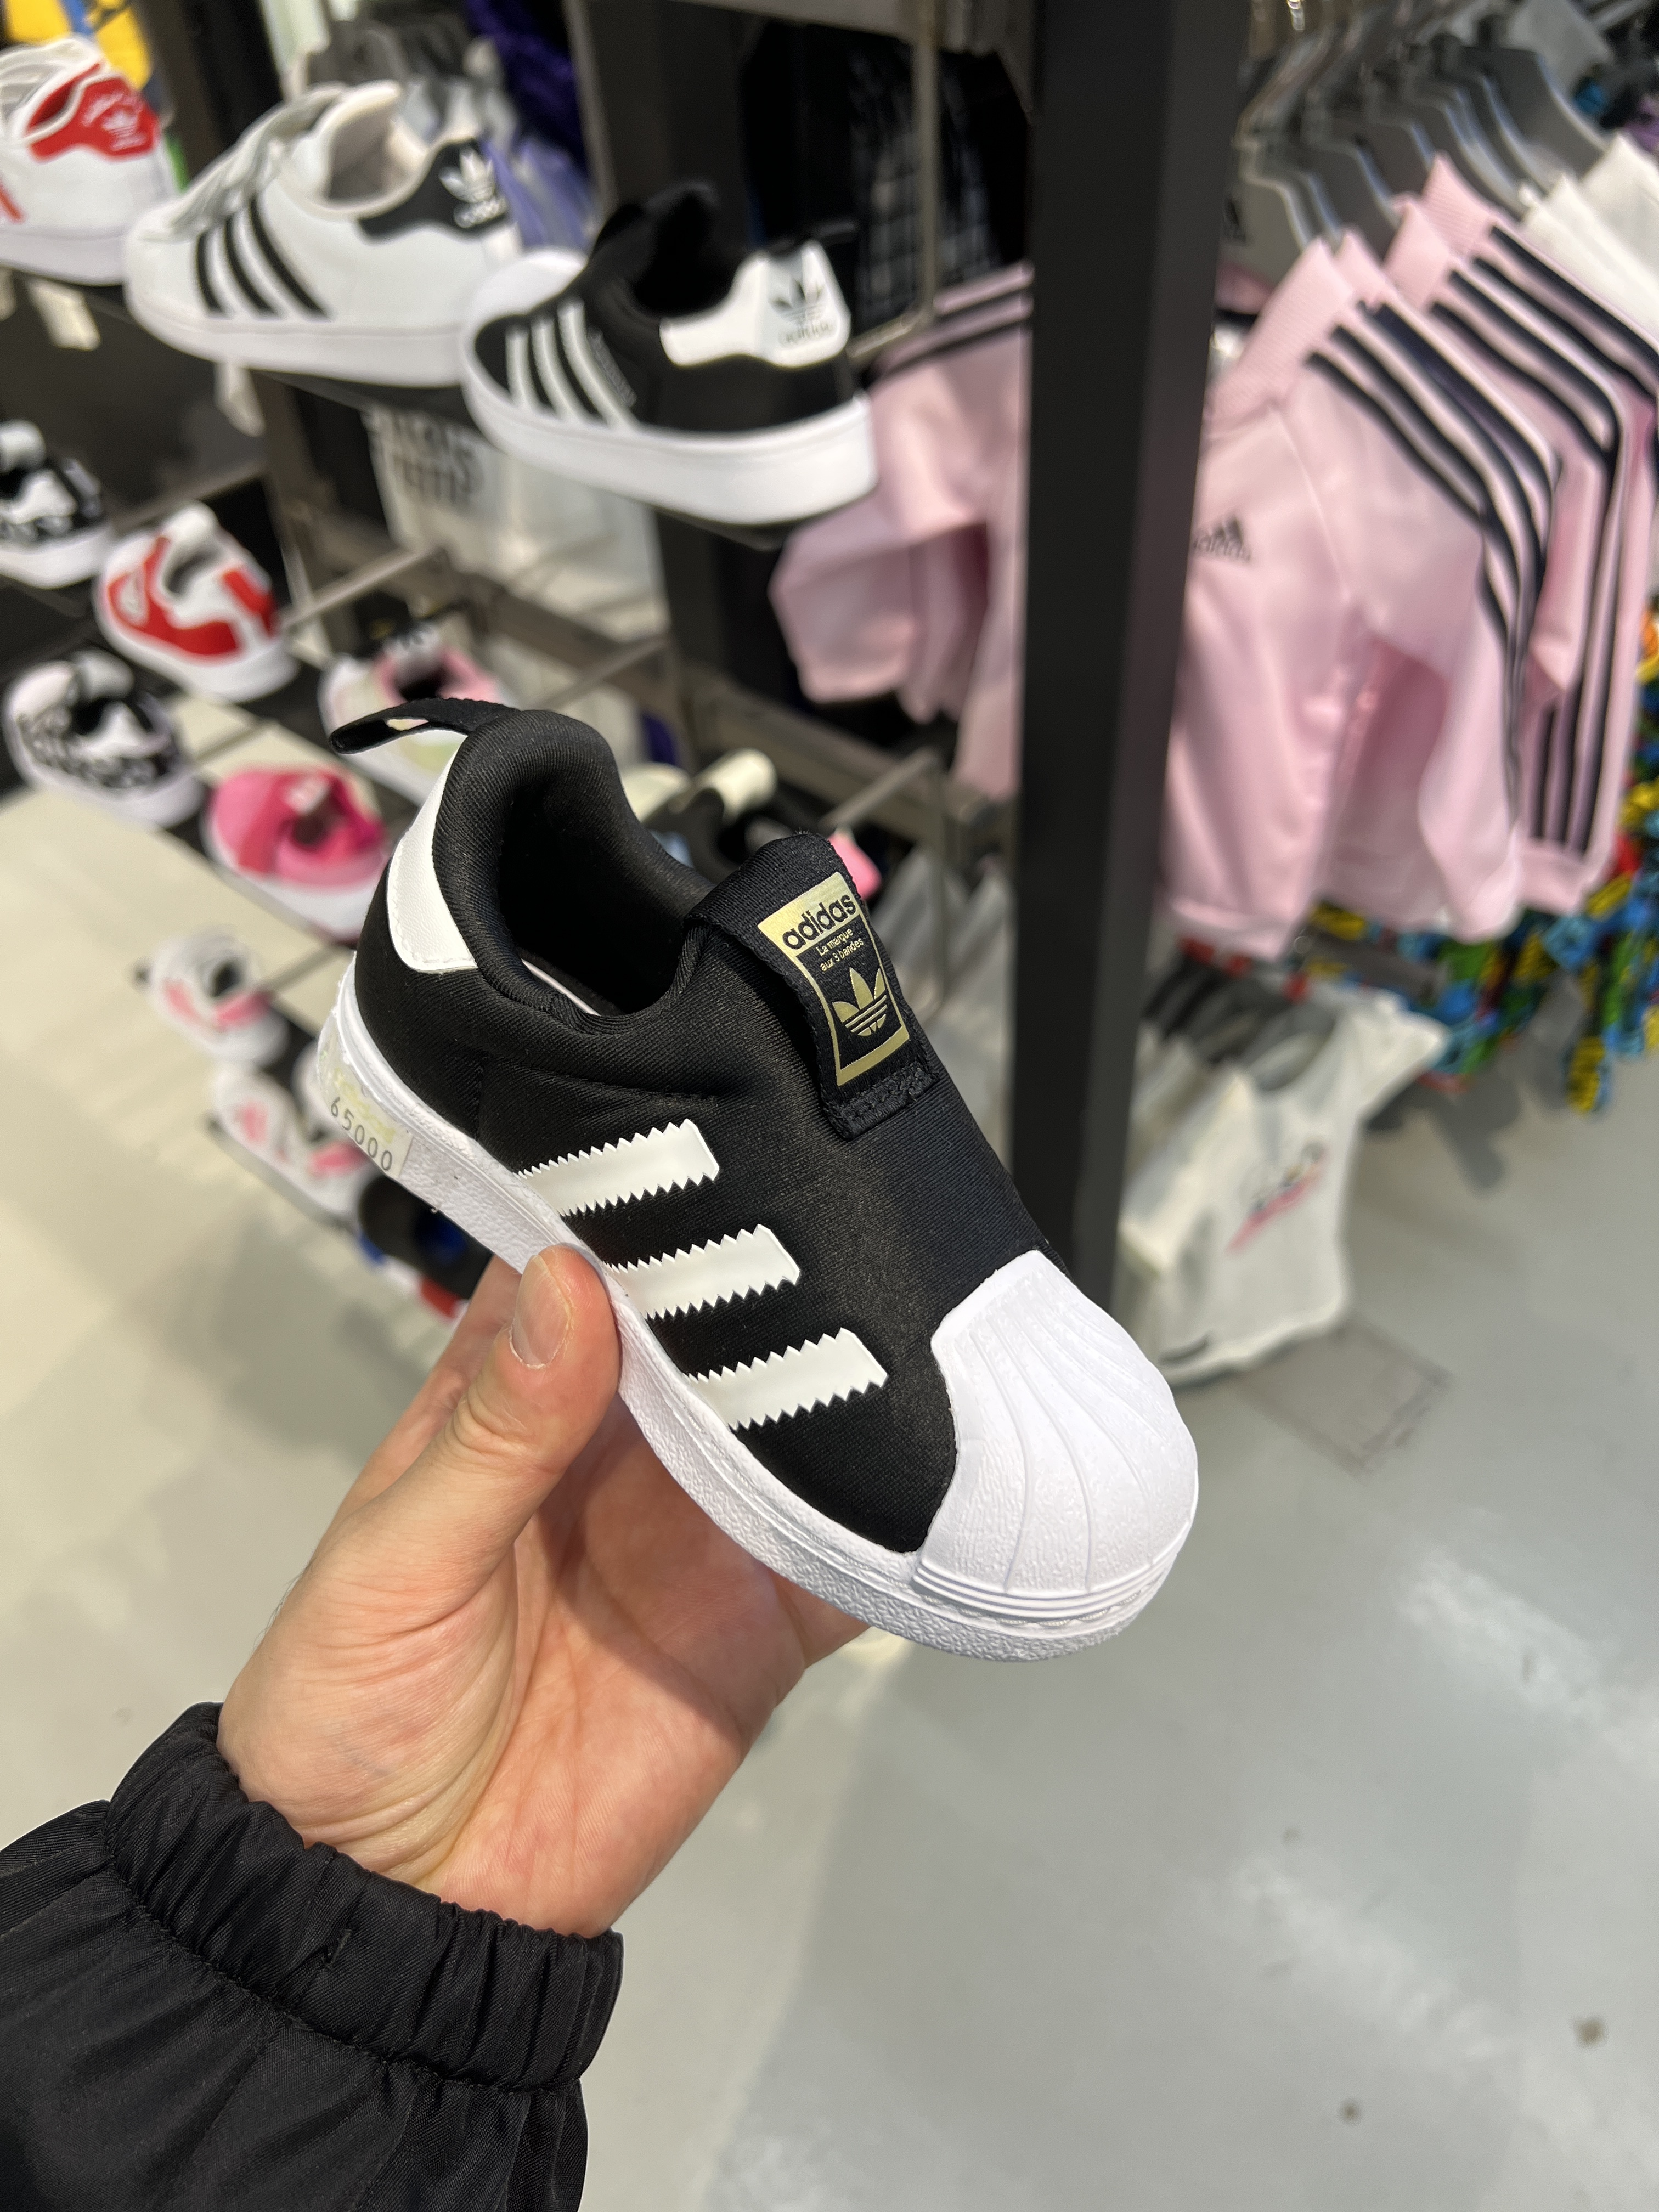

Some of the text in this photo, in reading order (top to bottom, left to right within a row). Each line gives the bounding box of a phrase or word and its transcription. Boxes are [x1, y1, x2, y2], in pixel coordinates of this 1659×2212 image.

[782, 894, 856, 950] adidas
[815, 928, 854, 956] La marque
[820, 938, 864, 972] aux 3 bandes
[331, 1096, 393, 1171] 65000
